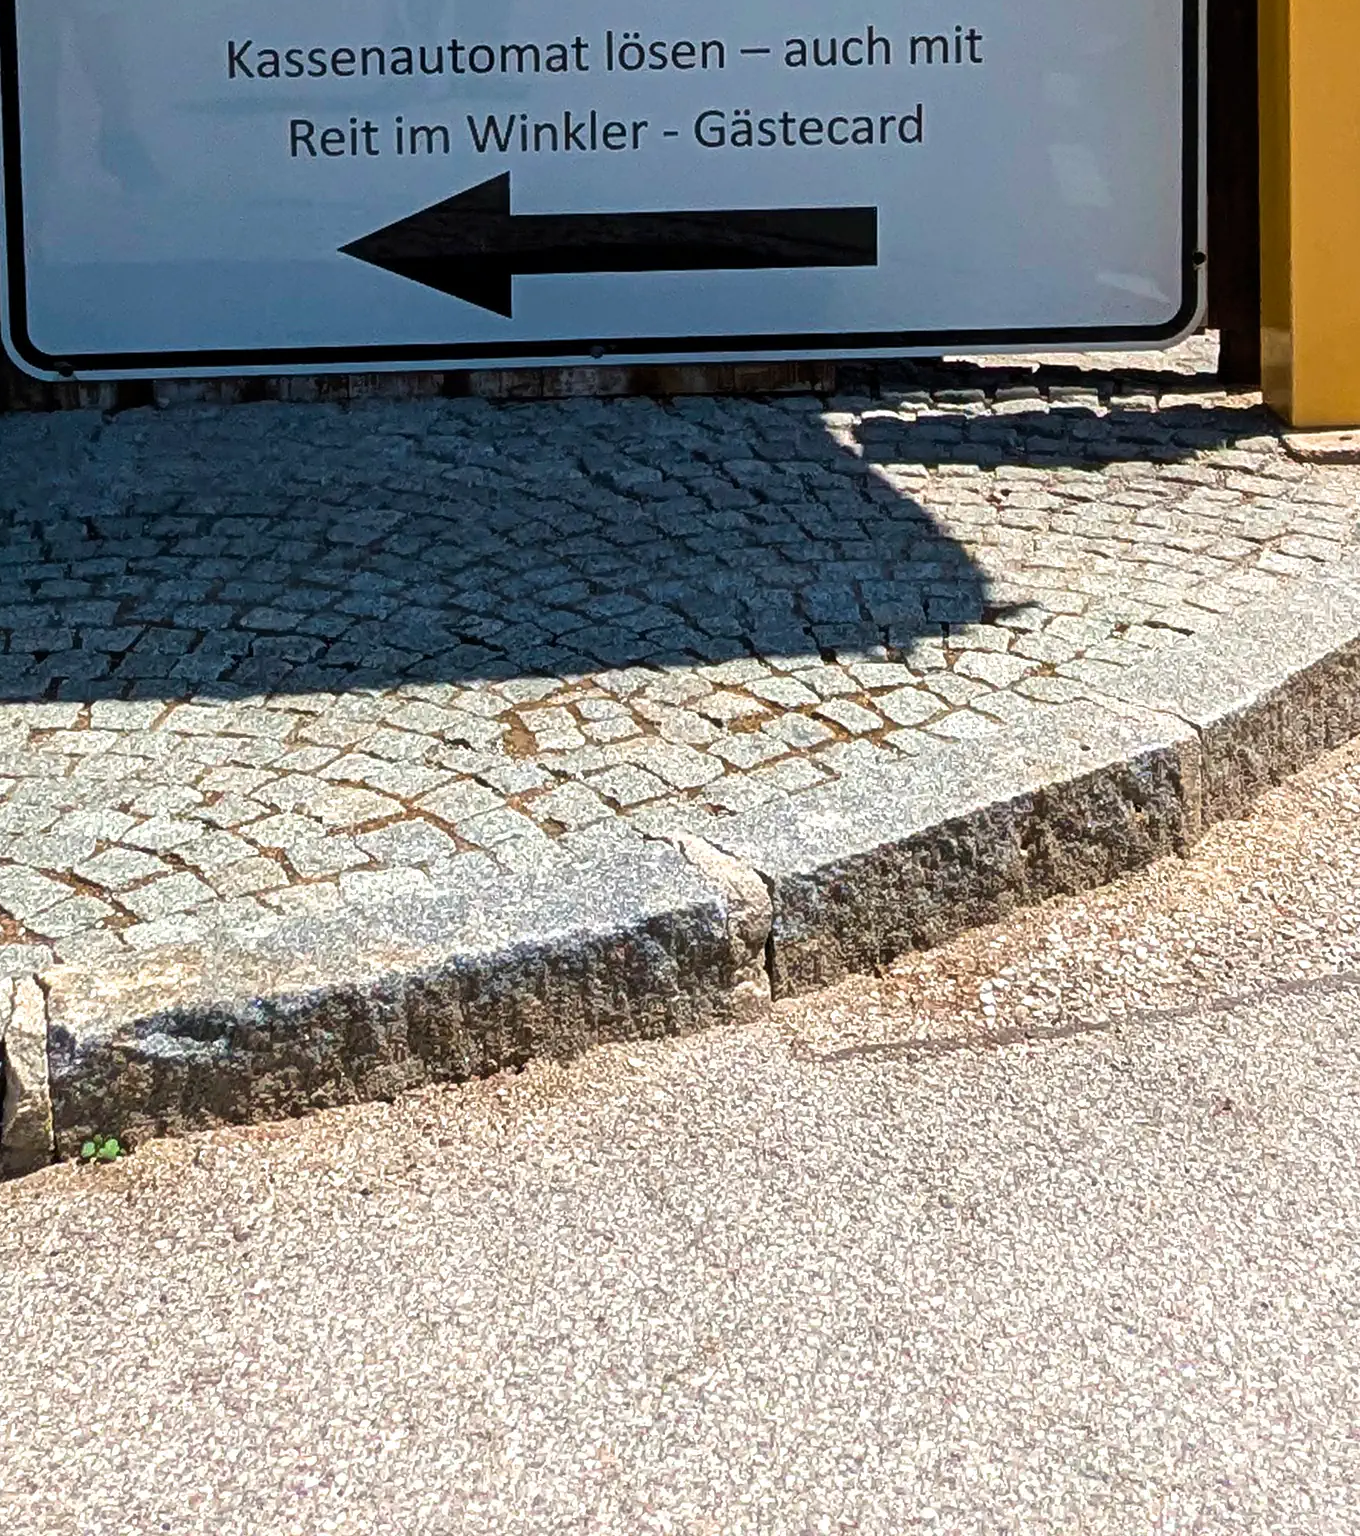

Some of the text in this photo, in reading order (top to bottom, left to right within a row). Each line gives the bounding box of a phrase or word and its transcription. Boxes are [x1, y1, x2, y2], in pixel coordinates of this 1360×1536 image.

[227, 34, 590, 79] Kassenautomat
[606, 28, 725, 70] lösen
[784, 24, 891, 68] auch
[910, 24, 983, 65] mit
[290, 116, 380, 157] Reit
[395, 113, 450, 155] im
[466, 108, 649, 153] Winkler
[694, 103, 923, 148] Gästecard
